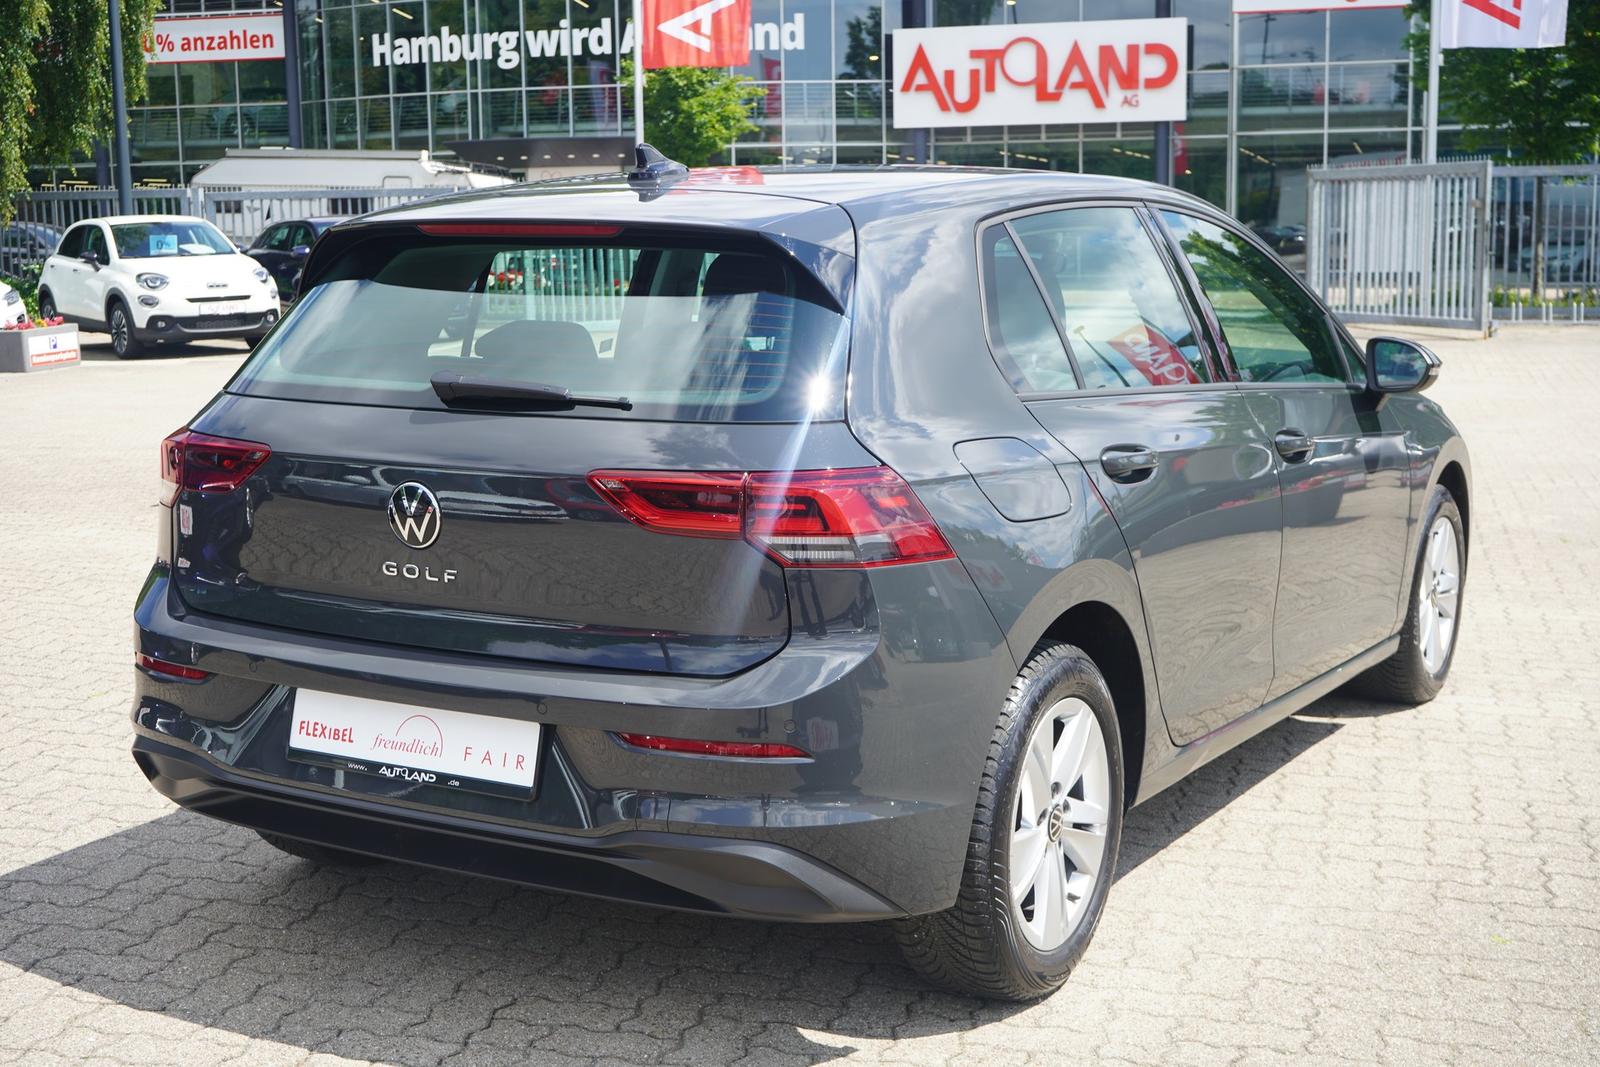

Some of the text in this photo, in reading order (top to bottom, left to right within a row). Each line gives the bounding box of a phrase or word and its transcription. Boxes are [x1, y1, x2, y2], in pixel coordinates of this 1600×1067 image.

[181, 30, 274, 52] anzahlen
[372, 26, 520, 70] Hamburg
[525, 17, 612, 57] wird
[900, 36, 1179, 113] AUTOLAND
[1120, 94, 1139, 108] AG
[382, 561, 458, 583] GOLF
[299, 719, 526, 771] FLEXIBEL freundlich FAIR
[347, 762, 368, 772] www.
[447, 778, 460, 788] .de
